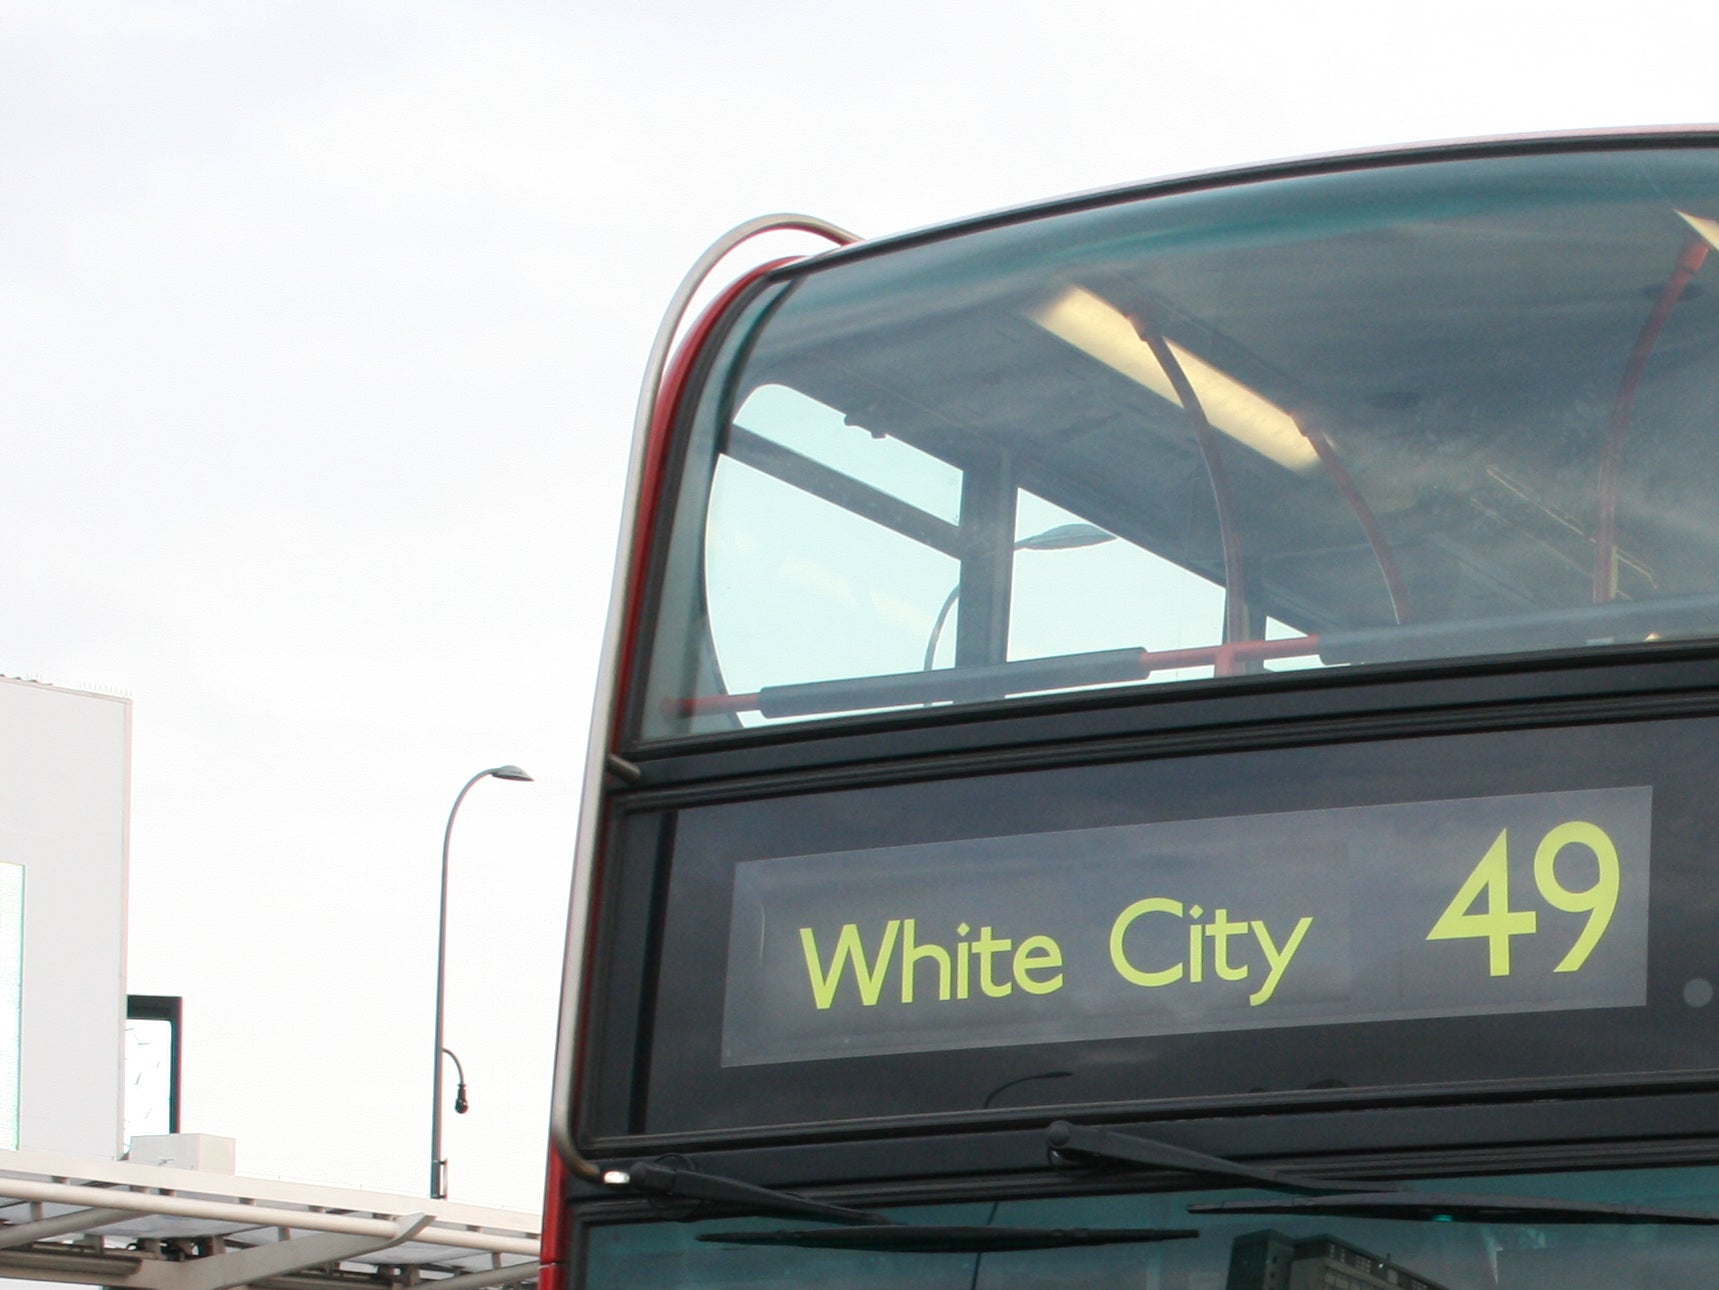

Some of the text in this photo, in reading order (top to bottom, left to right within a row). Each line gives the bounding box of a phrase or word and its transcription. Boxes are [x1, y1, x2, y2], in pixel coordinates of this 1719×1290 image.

[800, 819, 1622, 1010] White City 49
